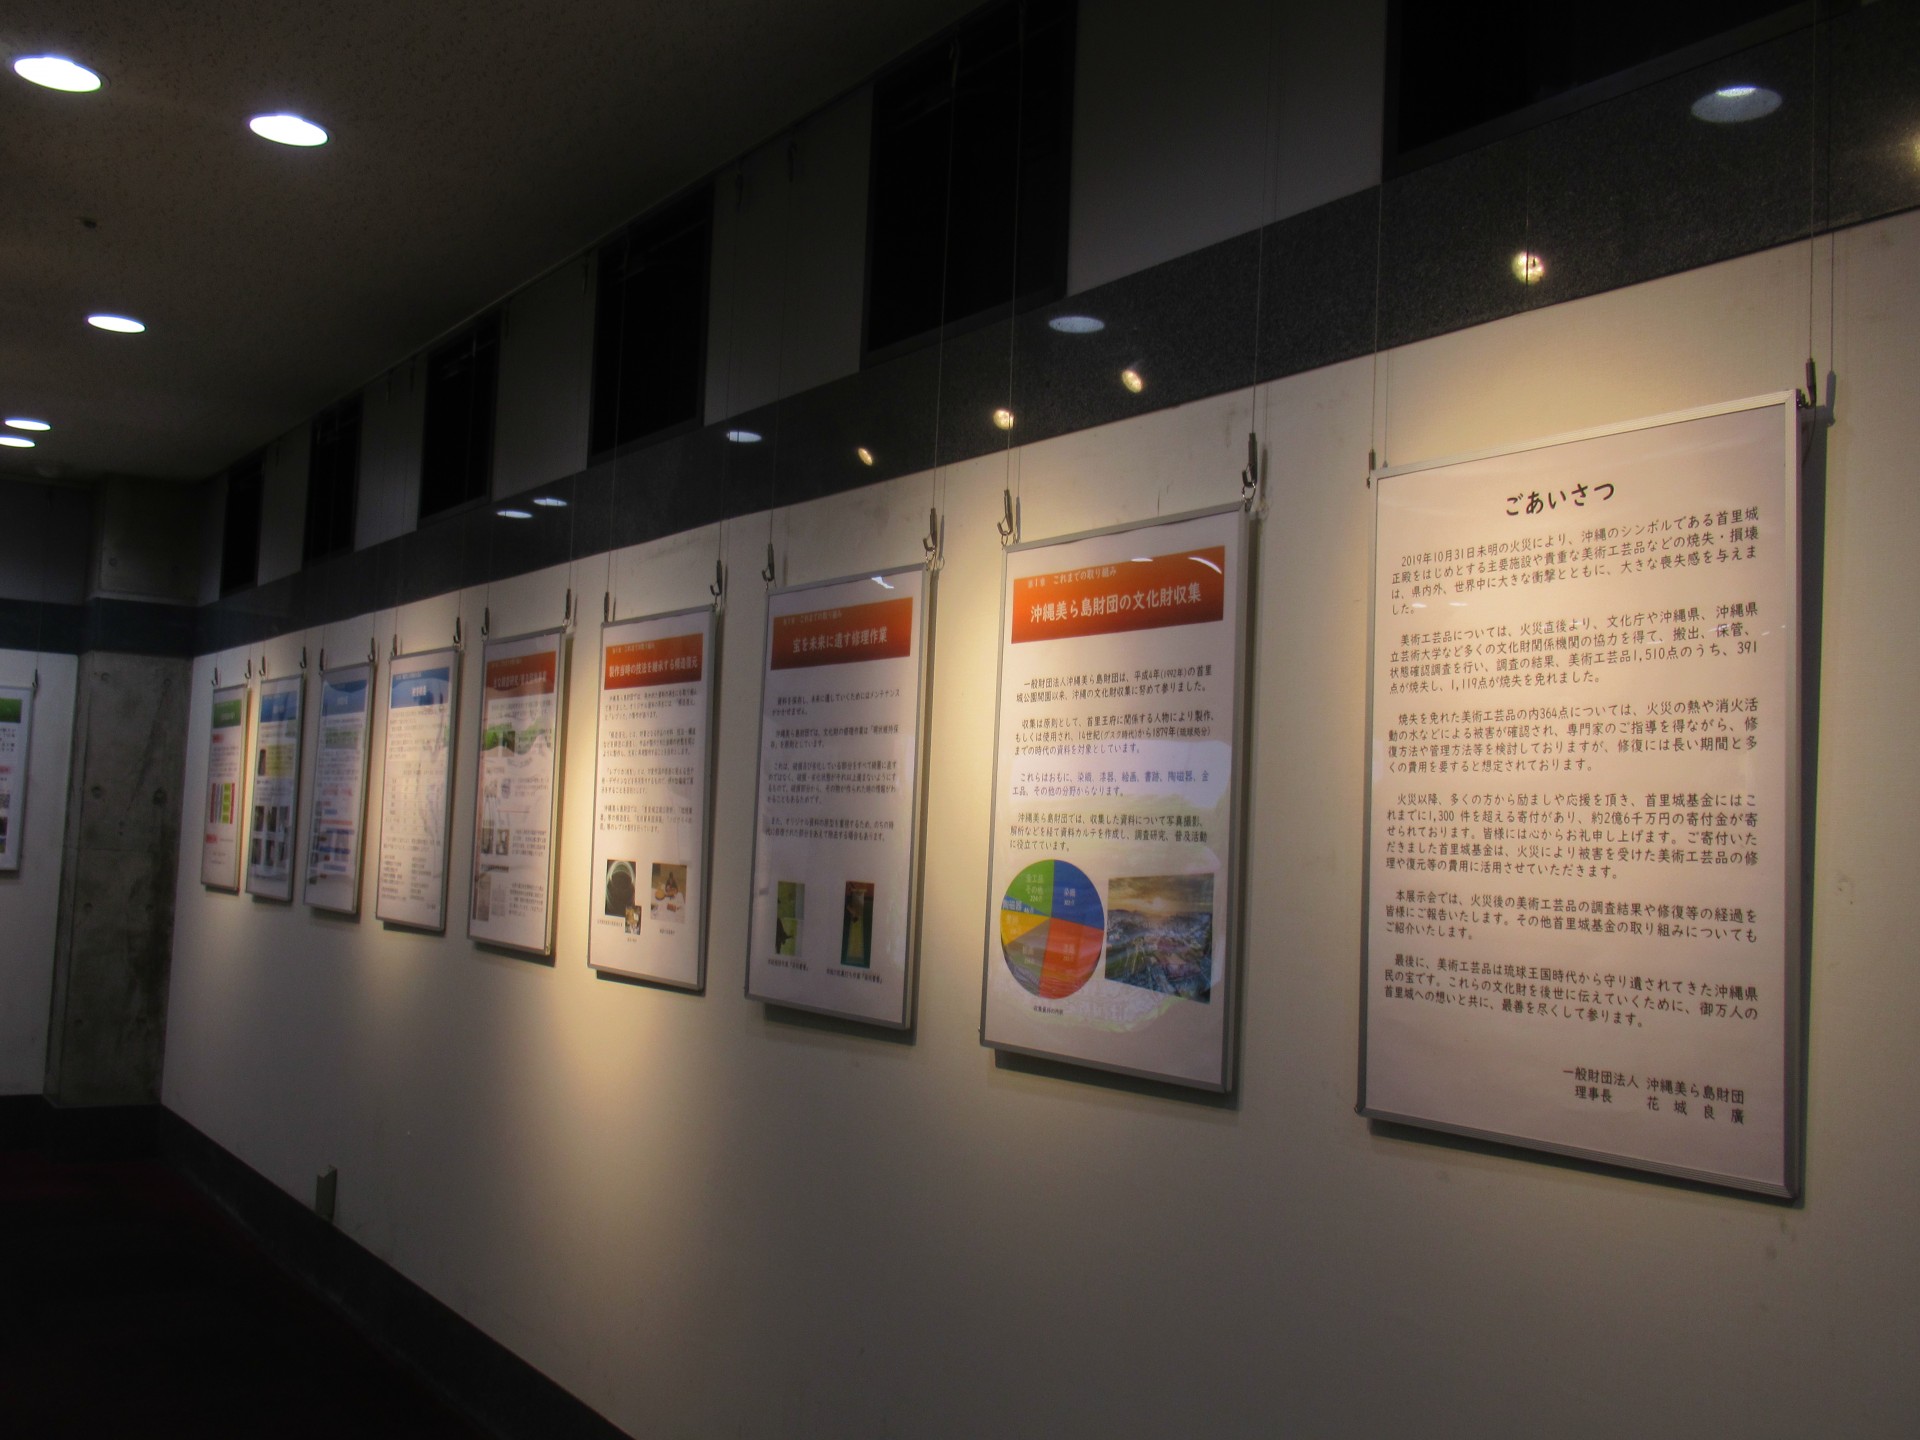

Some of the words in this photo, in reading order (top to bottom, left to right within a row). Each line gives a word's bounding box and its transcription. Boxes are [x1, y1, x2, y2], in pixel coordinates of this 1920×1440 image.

[1505, 480, 1616, 517] ごあいさつ
[1401, 506, 1759, 568] 2019年10月31日未明の火災により、沖縄のシンボルである首里城
[1391, 526, 1760, 585] 正殿をはじめとする主要施設や貴重な美術工芸品などの焼失・損壊
[1053, 566, 1117, 585] これまでの取り組み
[1391, 545, 1757, 600] は、県内外、世界中に大きな衝撃とともに、大きな喪失感を与えま
[1030, 582, 1202, 624] 沖縄美ら島財団の文化財収集
[1391, 603, 1415, 616] した。
[1400, 601, 1759, 647] 美術工芸品については、火災直後より、文化庁や沖縄県、沖縄県
[792, 626, 888, 653] 宝を未来に遺す修理作業
[1390, 622, 1750, 663] 立芸術大学など多くの文化財関係機関の協力を得て、搬出、保管、
[1389, 641, 1758, 679] 状態確認調査を行い、調査の結果、美術工芸品1,510点のうち、391
[1389, 669, 1600, 695] 点が焼失し、1,119点が焼失を免れました。
[1021, 710, 1215, 729] 収集は原則として、首里王府に関係する人物により製作、
[1398, 697, 1759, 726] 焼失を免れた美術工芸品の内364点については、火災の熱や消火活
[1388, 716, 1759, 742] 動の水などによる被害が確認され、専門家のご指導を得ながら、修
[1014, 743, 1140, 756] までの時代の資料を対象としています。
[1388, 735, 1758, 758] 復方法や管理方法等を検討しておりますが、修復には長い期間と多
[1388, 758, 1592, 774] くの費用を要すると想定されております。
[1012, 786, 1124, 797] 工品、その他の分野からなります。
[1396, 792, 1756, 809] 火災以降、多くの方から励ましや応援を頂き、首里城基金にはこ
[1386, 824, 1758, 847] せられております。皆様には心からお礼申し上げます。ご寄付いた
[1386, 841, 1759, 866] だきました首里城基金は、火災により被害を受けた美術工芸品の修
[1386, 857, 1618, 880] 理や復元等の費用に活用させていただきます。
[1395, 890, 1757, 924] 本展示会では、火災後の美術工芸品の調査結果や修復等の経過を
[1385, 905, 1758, 943] 皆様にご報告いたします。その他首里城基金の取り組みについても
[1385, 923, 1473, 941] ご紹介いたします。
[1395, 953, 1759, 1002] 最後に、美術工芸品は琉球王国時代から守り遺されてきた沖縄県
[1384, 969, 1758, 1021] 民の宝です。これらの文化財を後世に伝えていくために、御万人の
[1384, 986, 1643, 1028] 首里城への想いと共に、最善を尽くして参ります。
[1563, 1066, 1640, 1090] 一般財団法人
[1646, 1076, 1745, 1105] 沖縄美ら島財団
[1574, 1086, 1613, 1104] 理事長
